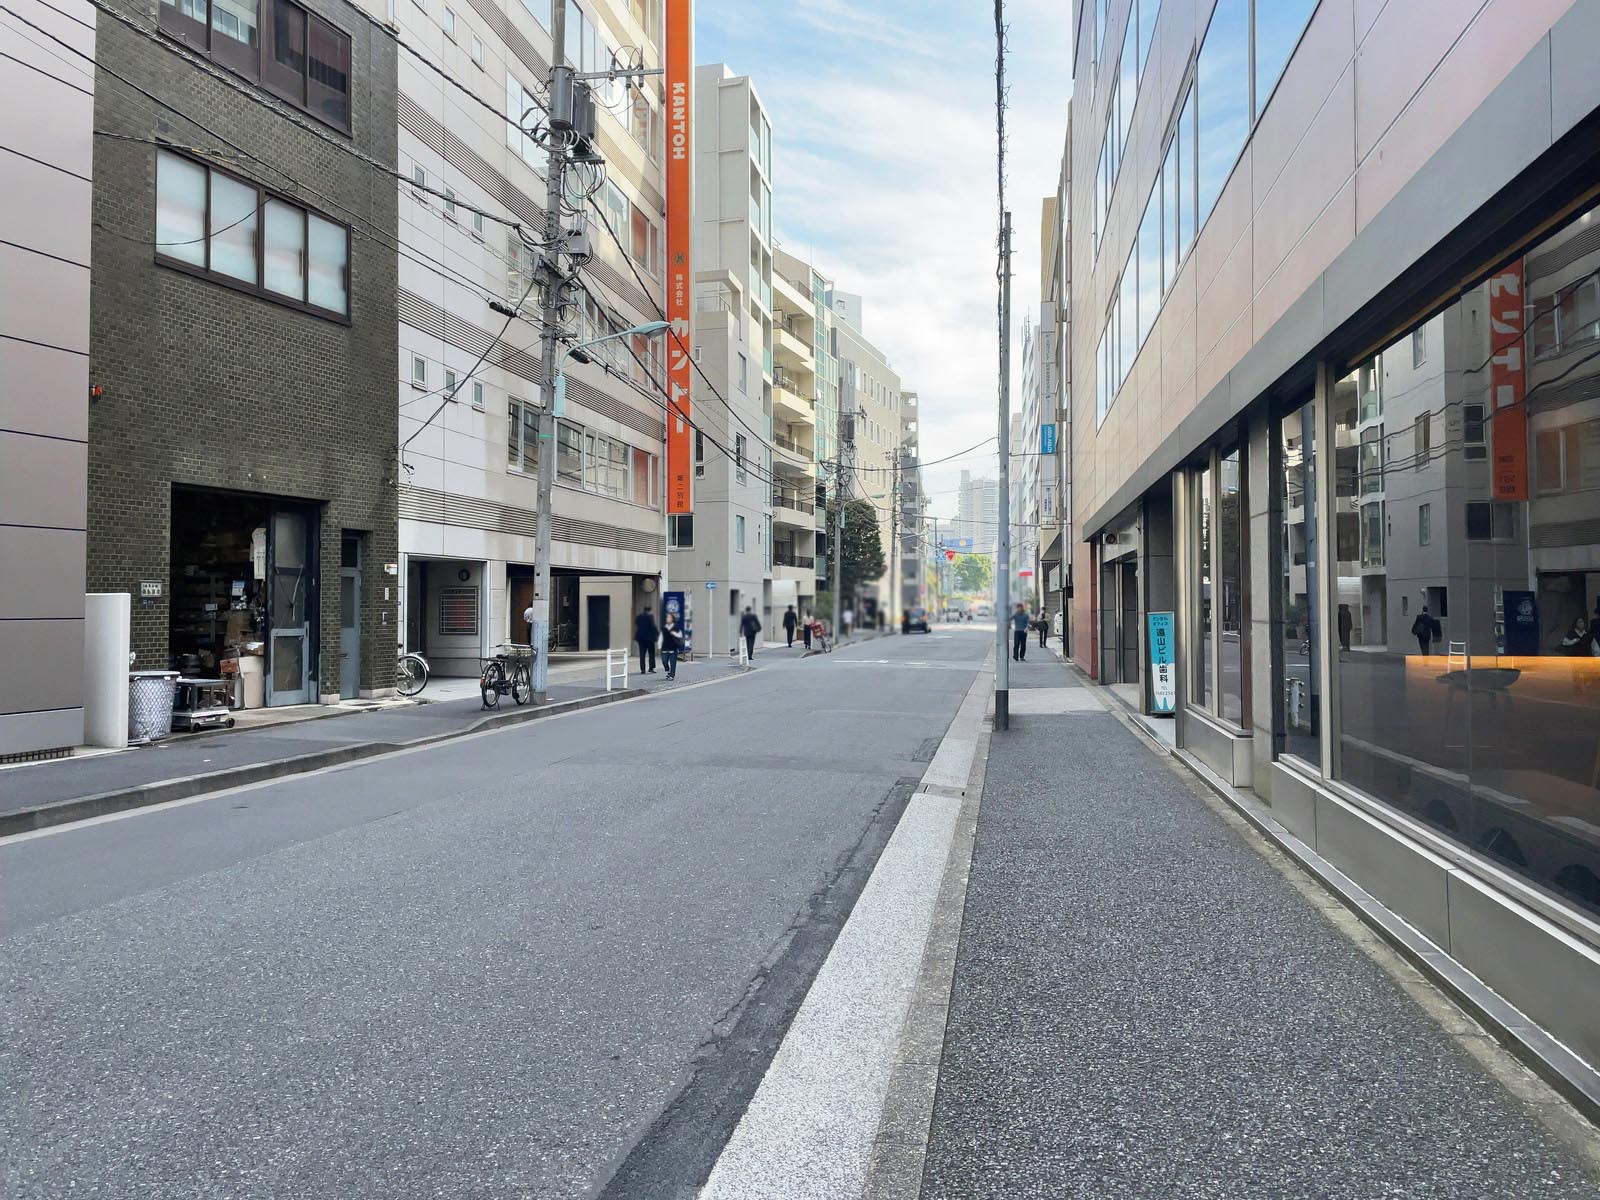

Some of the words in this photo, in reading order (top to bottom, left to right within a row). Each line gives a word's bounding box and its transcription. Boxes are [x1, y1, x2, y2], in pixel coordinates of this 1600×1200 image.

[672, 82, 686, 160] KANTOH
[675, 273, 684, 306] 株式会社
[671, 317, 689, 434] カントー
